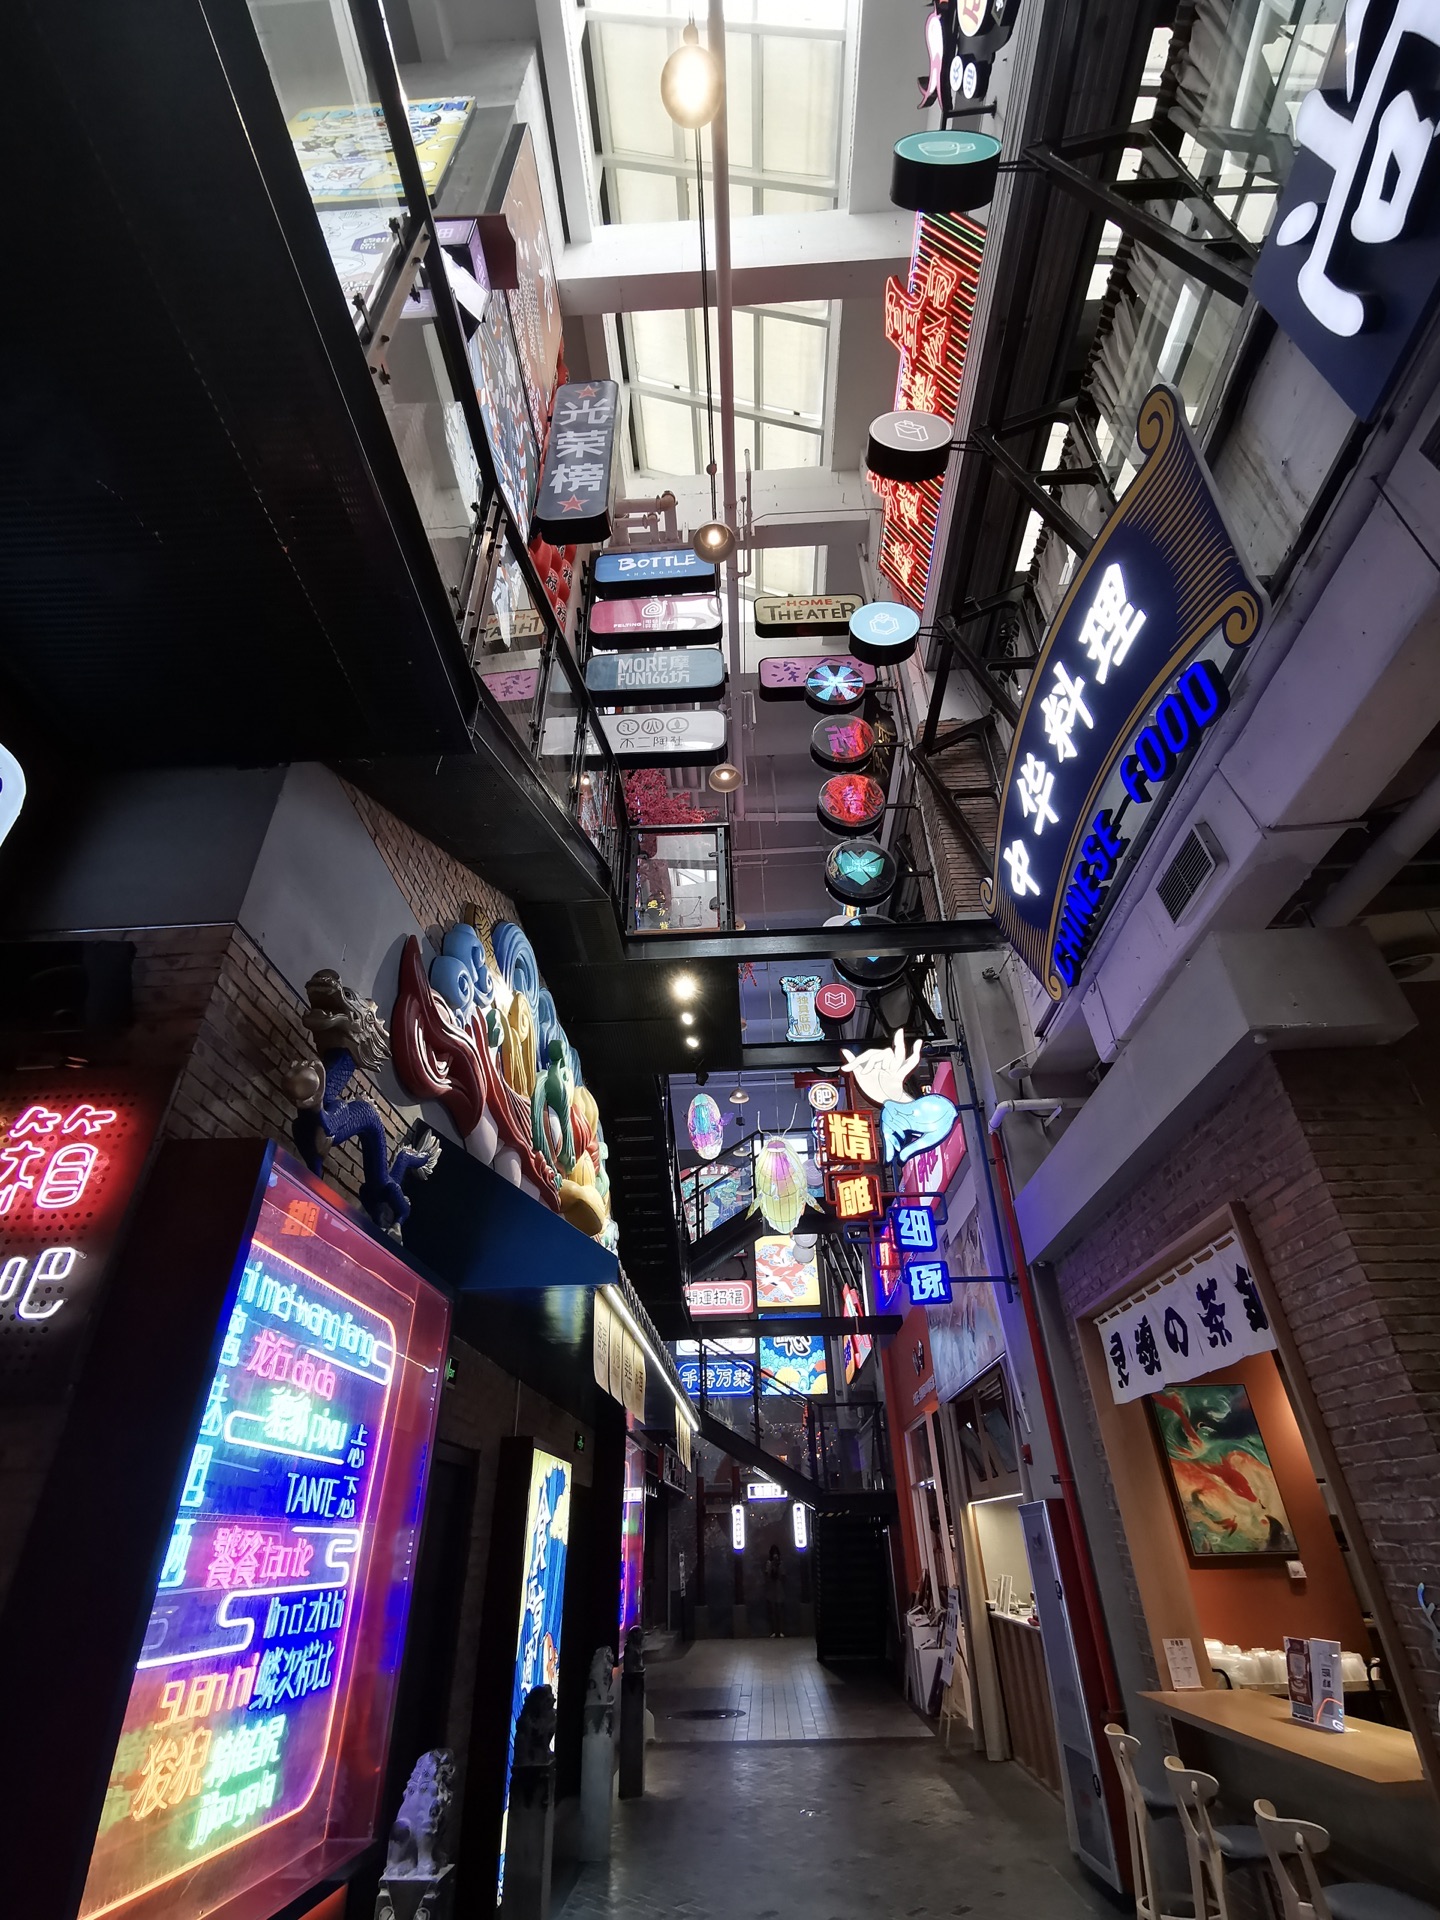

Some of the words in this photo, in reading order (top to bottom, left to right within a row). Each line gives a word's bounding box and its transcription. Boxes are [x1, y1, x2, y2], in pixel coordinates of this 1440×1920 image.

[550, 398, 610, 493] 光荣榜
[618, 554, 696, 571] BOTTLE
[626, 569, 687, 577] SHANGHAI
[763, 602, 856, 620] THEATER
[1003, 562, 1147, 897] 中华料理
[1053, 810, 1122, 987] CHINESE
[1120, 661, 1218, 804] FOOD
[685, 1288, 745, 1307] 開運招福
[681, 1367, 751, 1389] 千客万来
[285, 1472, 341, 1518] TANTE
